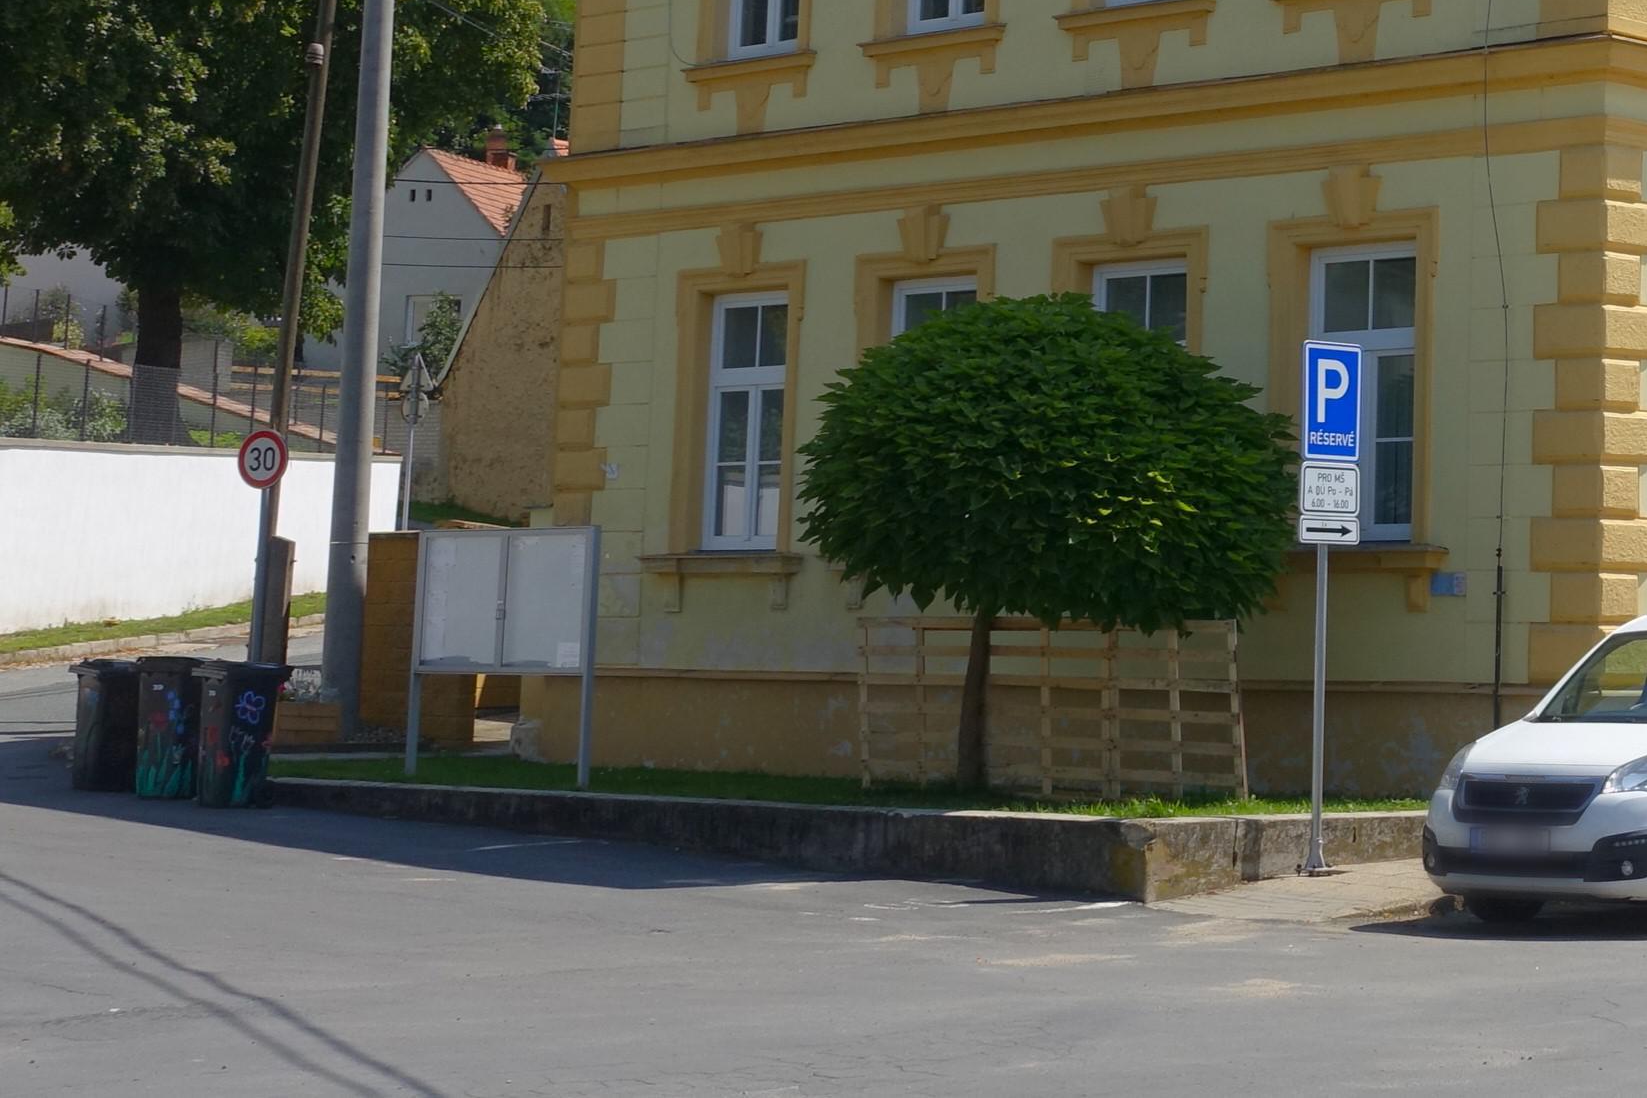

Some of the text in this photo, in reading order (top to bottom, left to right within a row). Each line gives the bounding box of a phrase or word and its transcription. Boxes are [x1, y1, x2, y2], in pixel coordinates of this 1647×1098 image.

[1317, 358, 1350, 423] P
[1309, 429, 1355, 447] RÉSERVÉ
[249, 447, 275, 471] 30
[1317, 472, 1345, 484] PRO MŠ
[1307, 486, 1313, 494] A
